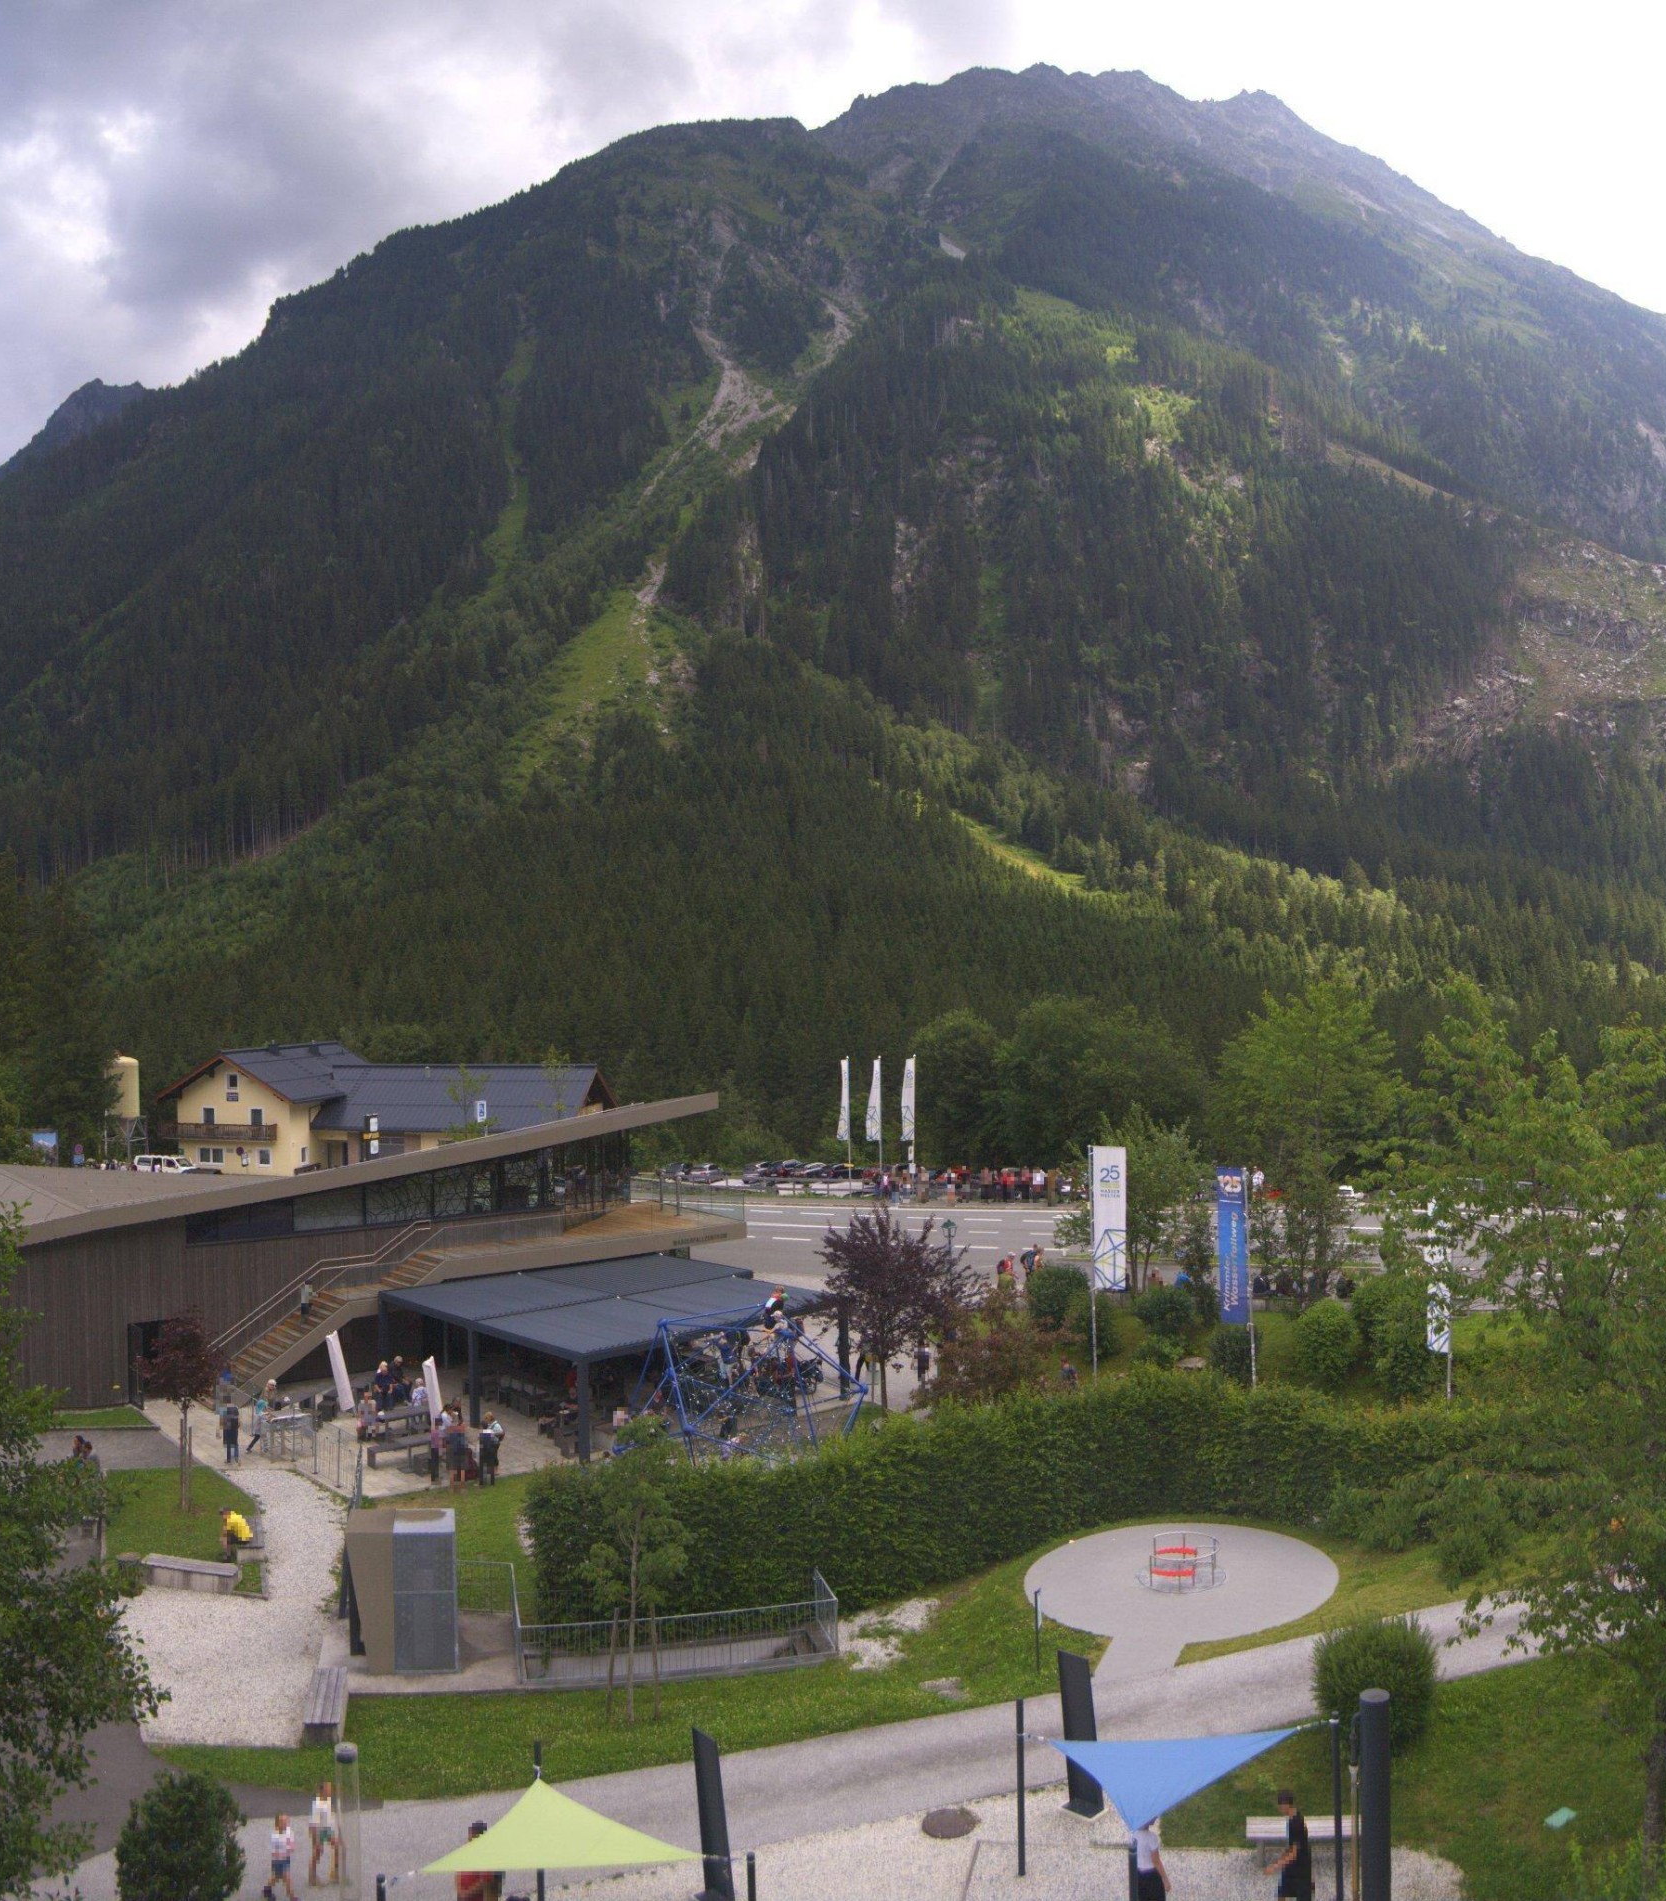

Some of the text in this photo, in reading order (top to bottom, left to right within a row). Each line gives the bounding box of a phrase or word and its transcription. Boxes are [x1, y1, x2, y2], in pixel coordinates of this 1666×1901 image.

[1100, 1165, 1120, 1182] 25
[1223, 1255, 1231, 1312] Krimmler
[1230, 1211, 1239, 1307] Wasserfallweg
